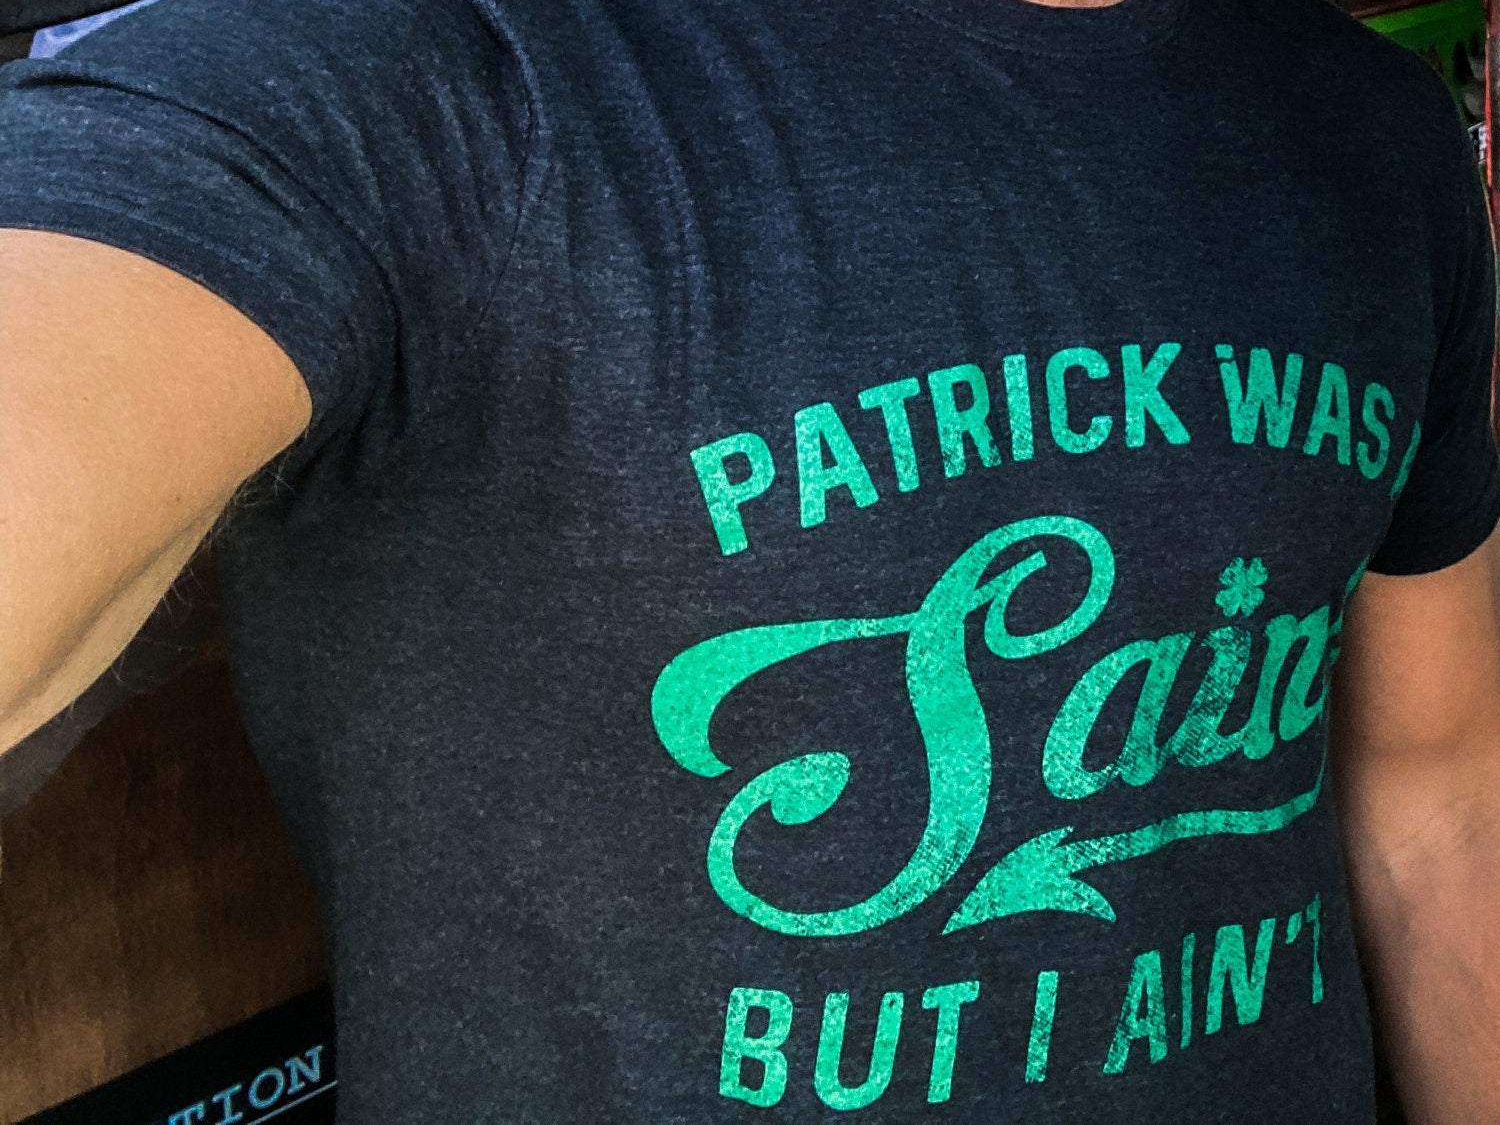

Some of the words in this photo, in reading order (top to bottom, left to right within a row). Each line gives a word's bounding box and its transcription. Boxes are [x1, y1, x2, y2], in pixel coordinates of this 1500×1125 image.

[690, 342, 1191, 557] PATRICK
[1214, 343, 1396, 480] WAS
[718, 979, 981, 1111] BUT
[1024, 970, 1060, 1083] I
